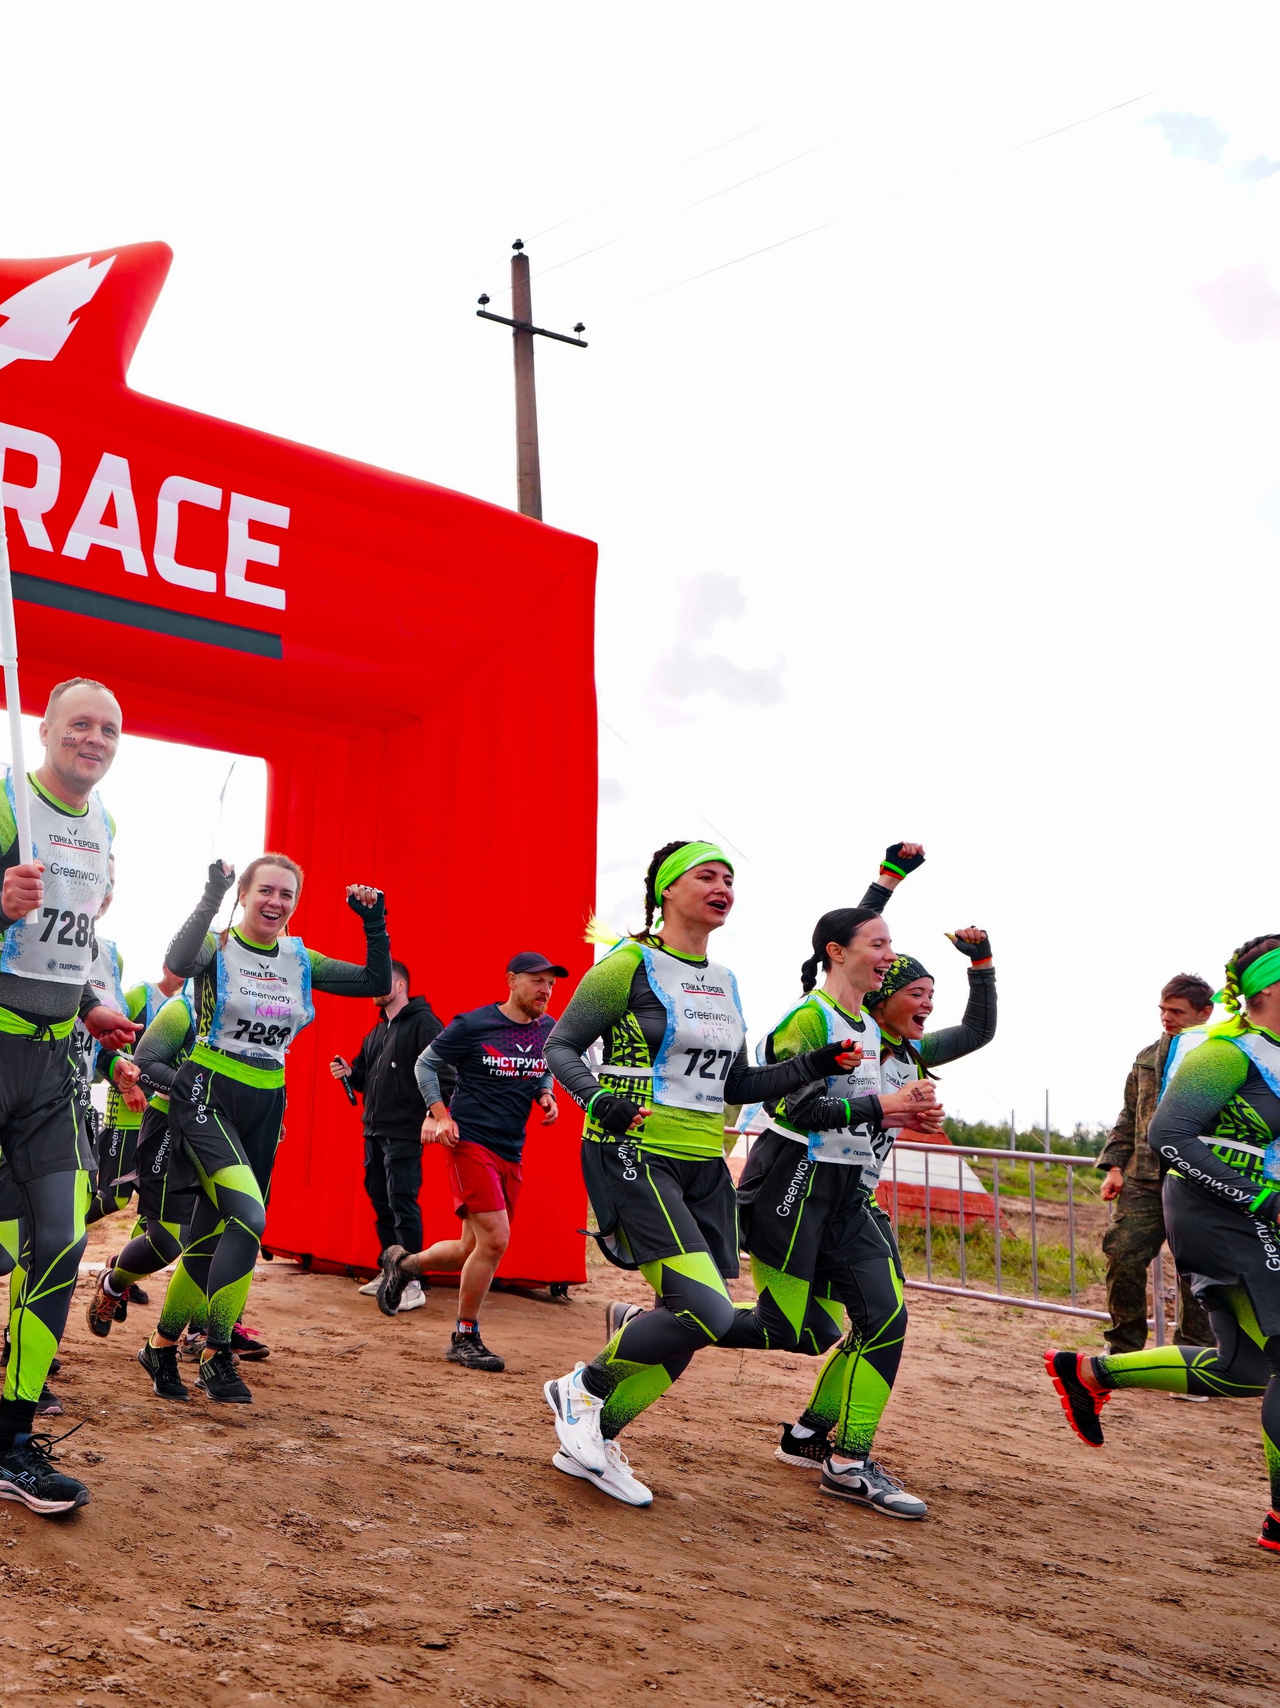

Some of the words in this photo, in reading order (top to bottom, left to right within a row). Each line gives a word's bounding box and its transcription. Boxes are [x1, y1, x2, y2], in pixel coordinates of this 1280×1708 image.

[48, 833, 74, 846] ГОНКА
[73, 838, 101, 851] ГЕРОЕВ
[50, 862, 99, 885] Greenway
[239, 986, 290, 1004] Greenway
[683, 1008, 732, 1024] Greenway
[482, 1055, 548, 1070] ИНСТРУКТ
[489, 1068, 520, 1077] ГОНКА
[1160, 1145, 1250, 1203] Greenway
[776, 1154, 814, 1217] Greenway
